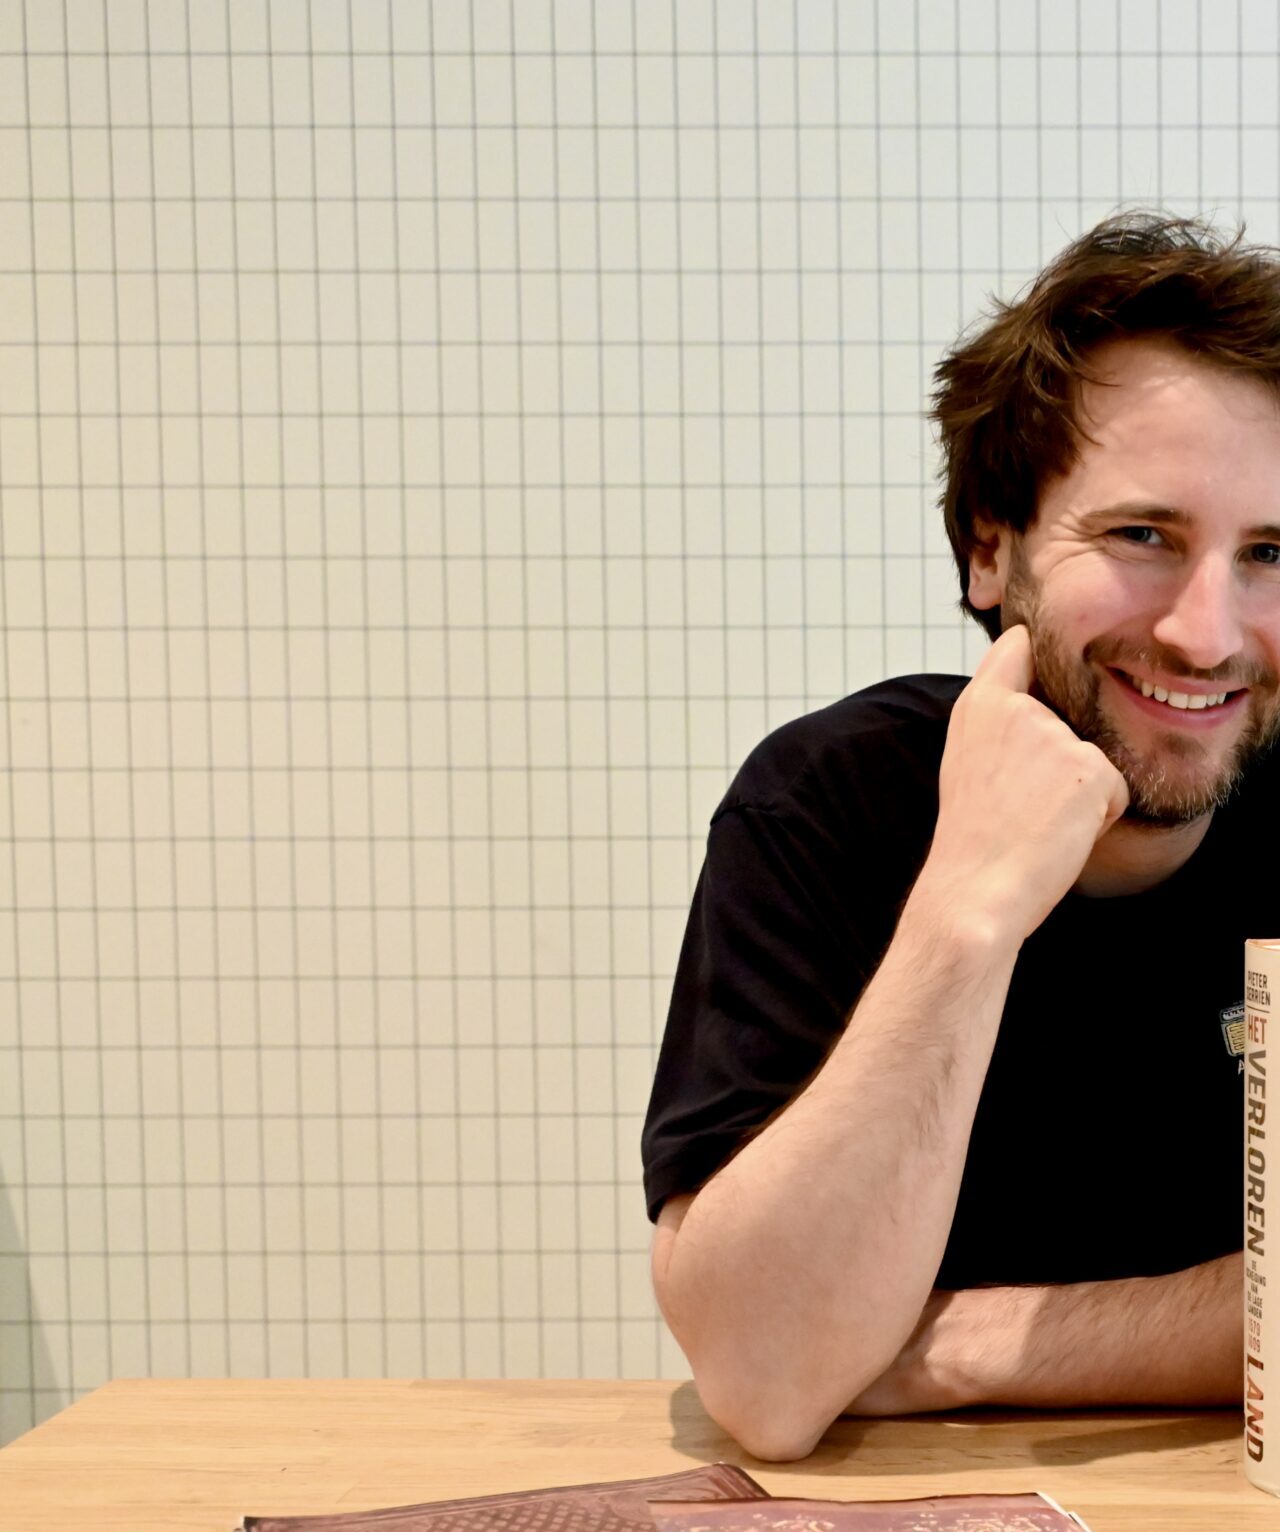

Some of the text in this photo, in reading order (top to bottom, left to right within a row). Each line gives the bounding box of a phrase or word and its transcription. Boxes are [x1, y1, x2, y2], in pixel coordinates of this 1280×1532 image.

[1247, 1013, 1267, 1045] HET
[1247, 1049, 1267, 1257] VERLOREN
[1246, 1352, 1265, 1463] LAND
